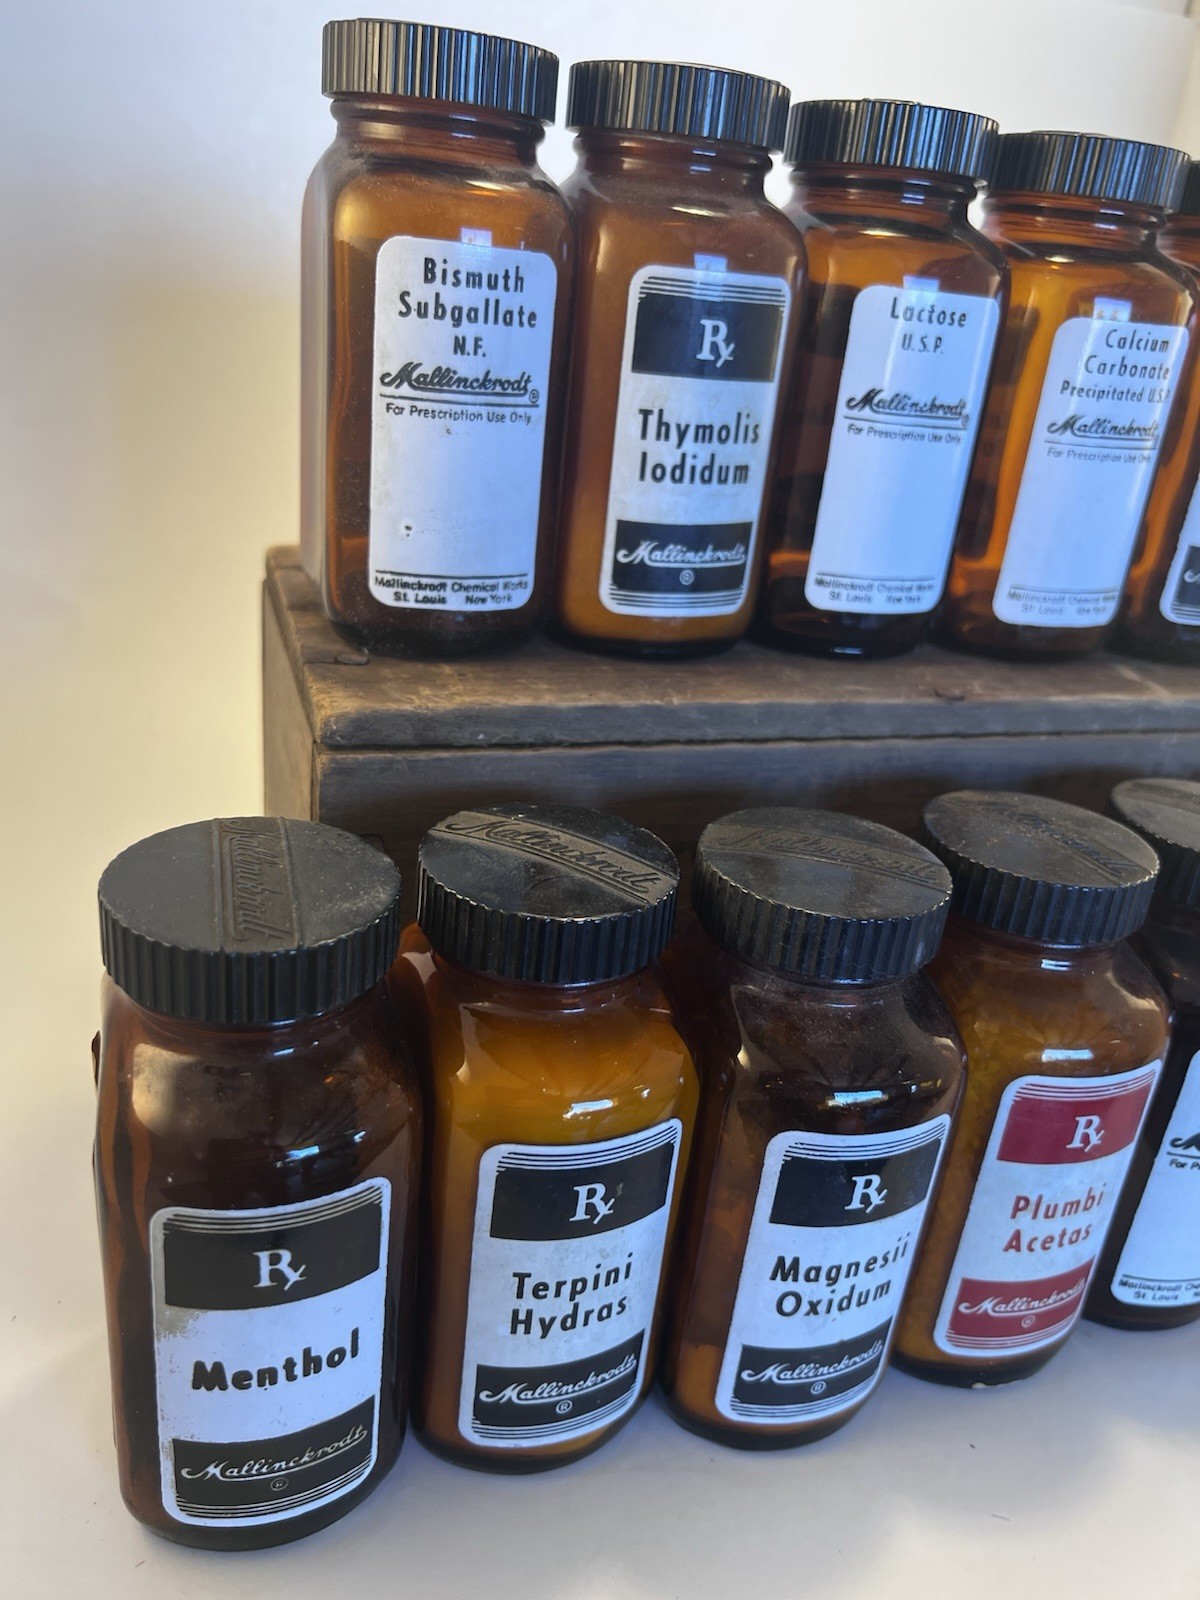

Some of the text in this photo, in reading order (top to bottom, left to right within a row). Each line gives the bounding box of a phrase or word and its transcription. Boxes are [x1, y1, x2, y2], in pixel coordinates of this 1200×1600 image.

[423, 257, 524, 293] Bismuth
[398, 291, 537, 328] Subgallate
[890, 296, 967, 328] Lactose
[453, 335, 487, 357] N.F.
[901, 333, 944, 355] U.S.P.
[1105, 328, 1170, 353] Calcium
[380, 362, 532, 397] Mallinckrodt
[1084, 354, 1170, 380] Carbonate
[845, 388, 967, 421] Mallinckrodt
[1060, 380, 1145, 403] Precipitated
[386, 403, 531, 426] For Prescription Use Only
[638, 408, 760, 449] Thymolis
[1047, 414, 1159, 442] Mallinckrodt
[847, 423, 865, 435] For
[866, 426, 925, 442] Prescription
[638, 451, 750, 485] Iodidum
[616, 540, 746, 569] Mallinckrodt
[375, 576, 528, 593] Mallinckrodt Chemical Works
[415, 593, 447, 604] Louis
[465, 595, 487, 605] New
[490, 594, 512, 604] York
[445, 820, 663, 893] Mallinckrodt
[1169, 1158, 1188, 1169] For
[1009, 1182, 1107, 1220] Plumbi
[1003, 1223, 1092, 1253] Acetas
[769, 1232, 911, 1287] Magnesii
[512, 1252, 633, 1302] Terpini
[775, 1279, 892, 1317] Oxidum
[958, 1278, 1086, 1317] Mallinckrodt
[510, 1296, 627, 1340] Hydras
[191, 1327, 360, 1391] Menthol
[740, 1339, 884, 1384] Mallinckrodt
[479, 1352, 637, 1405] Mallinckrodt
[181, 1424, 368, 1482] Mallinckrodt
